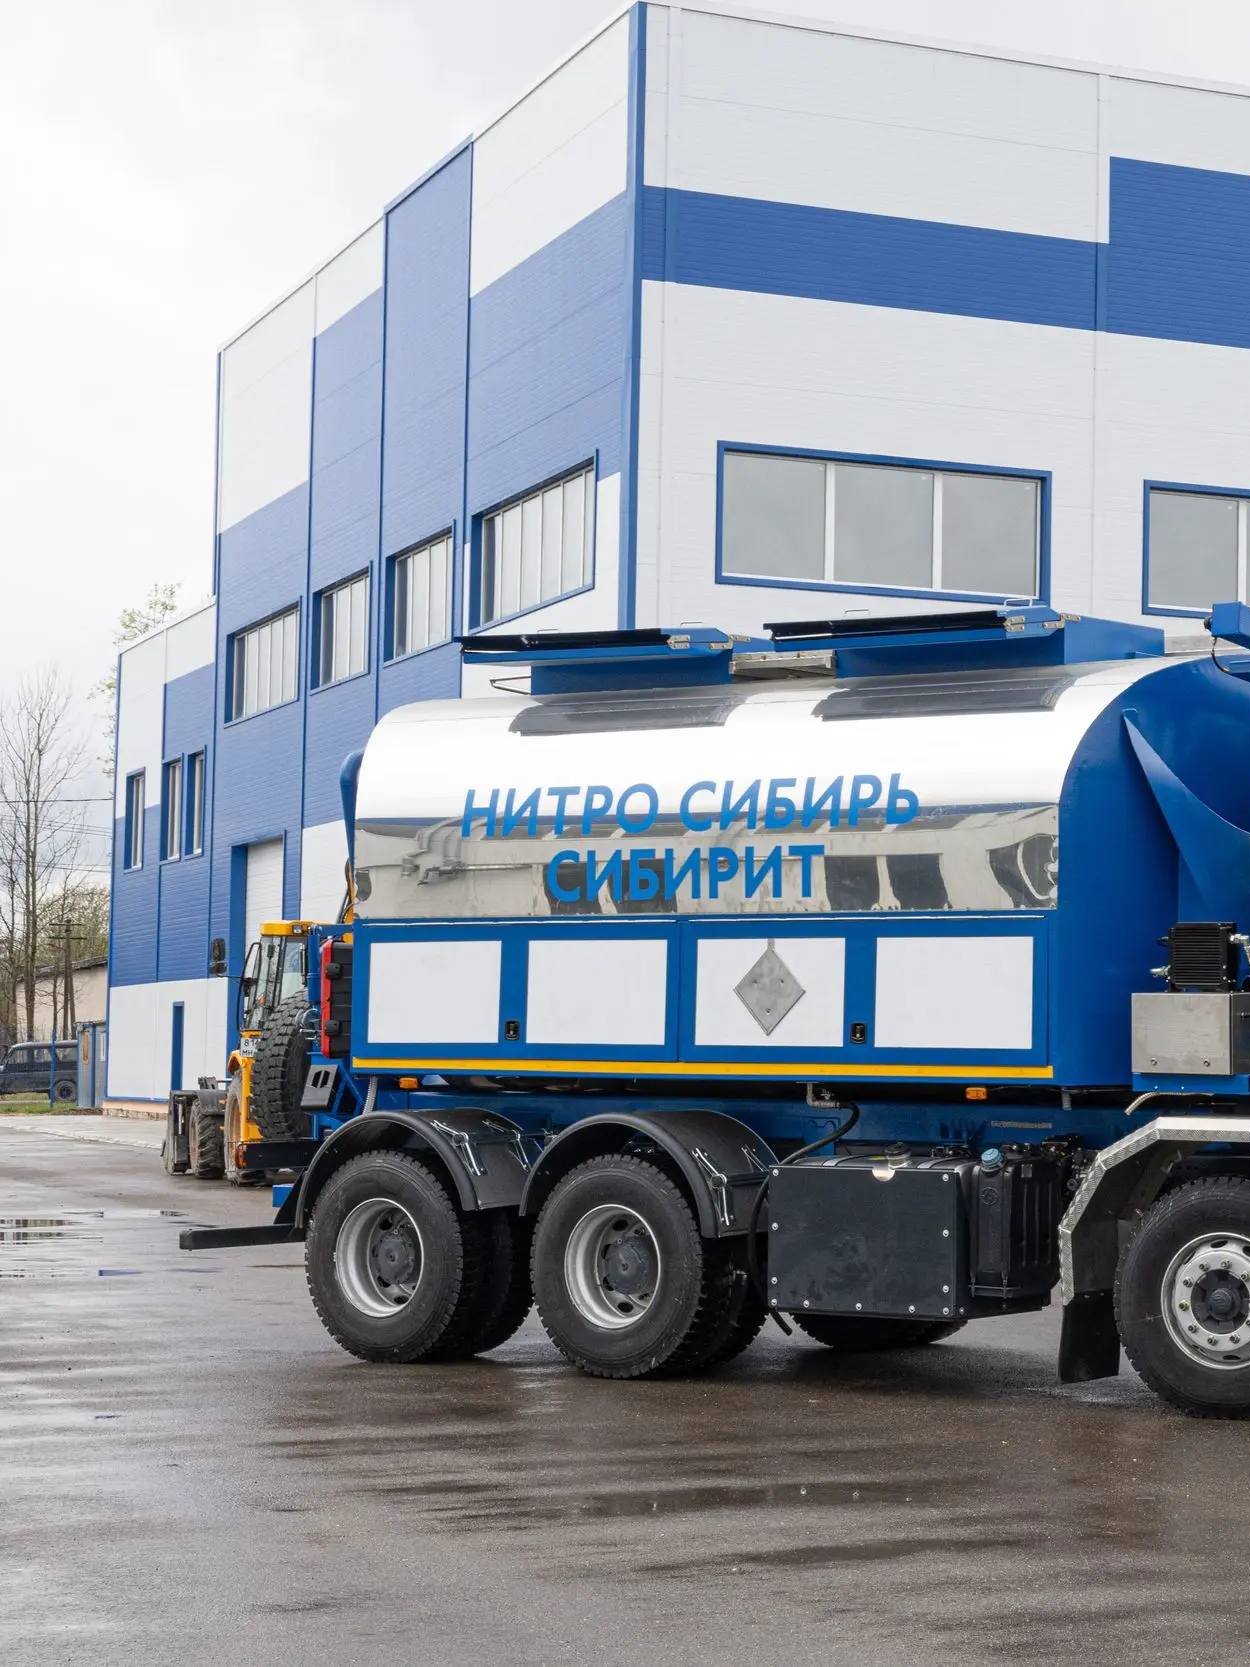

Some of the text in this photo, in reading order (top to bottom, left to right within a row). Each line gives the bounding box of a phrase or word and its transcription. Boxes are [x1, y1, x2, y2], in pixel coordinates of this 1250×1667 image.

[461, 773, 920, 838] НИТРО СИБИРЬ
[546, 845, 826, 903] СИБИРИТ
